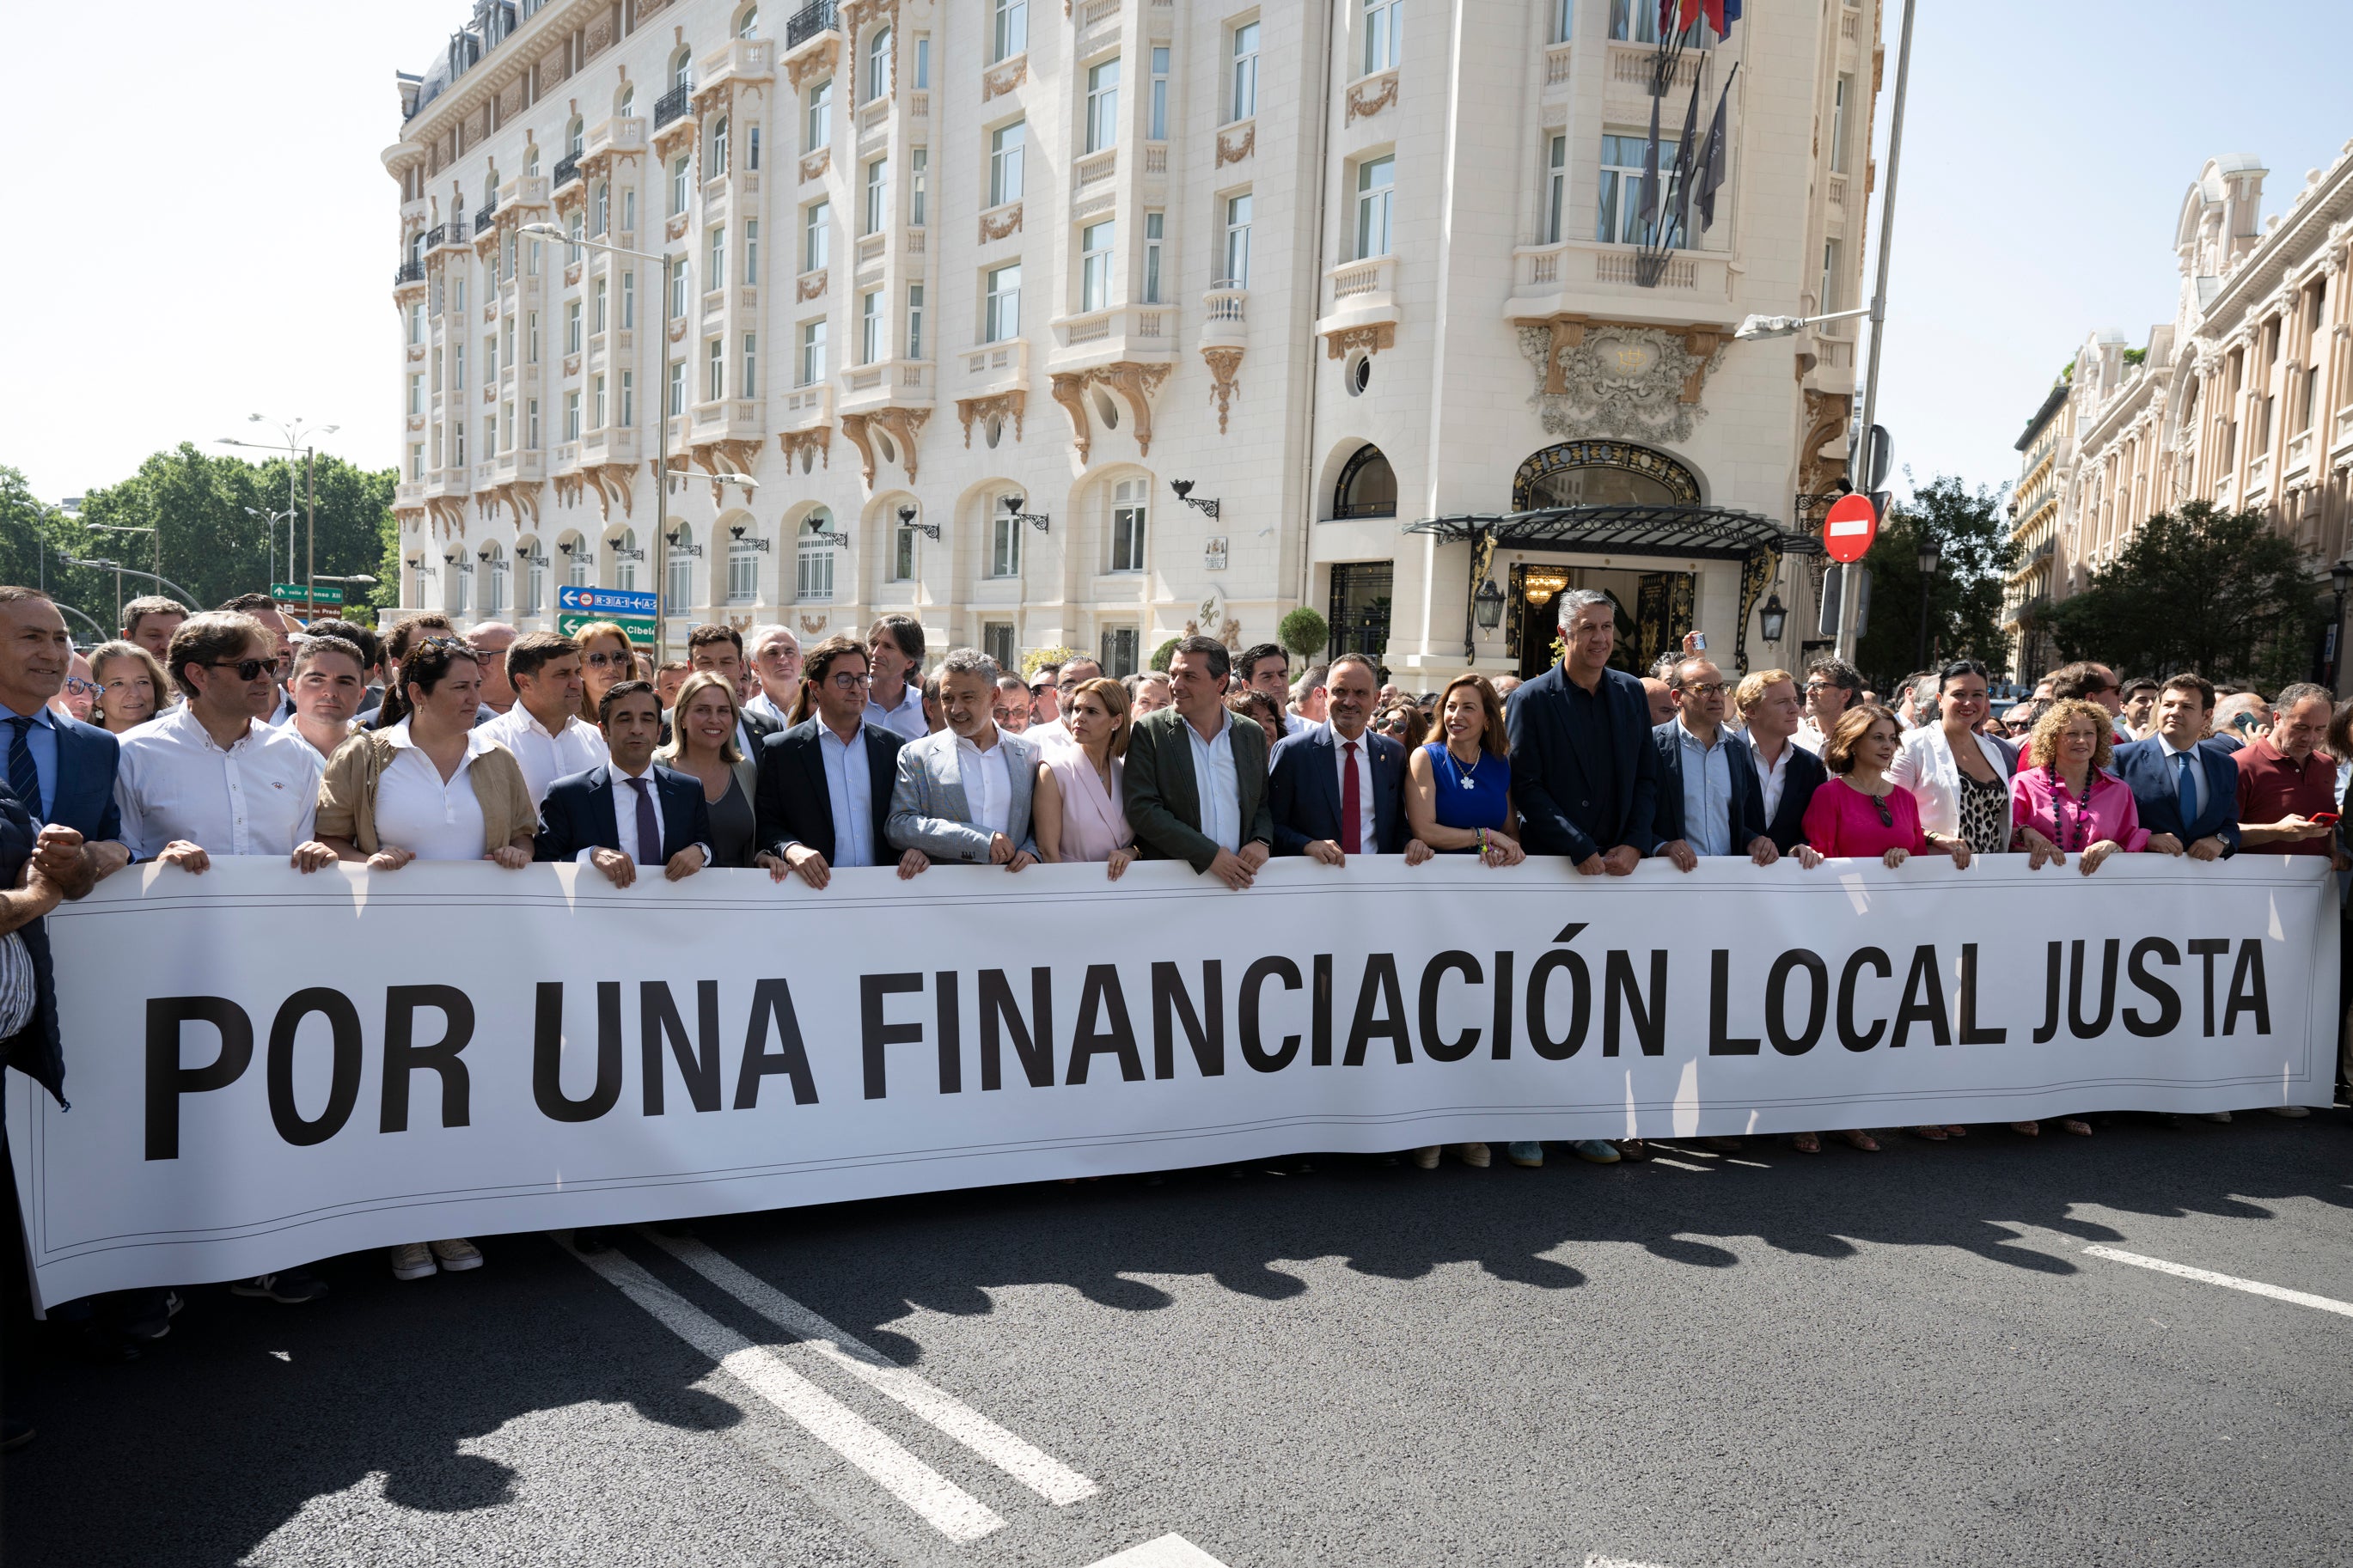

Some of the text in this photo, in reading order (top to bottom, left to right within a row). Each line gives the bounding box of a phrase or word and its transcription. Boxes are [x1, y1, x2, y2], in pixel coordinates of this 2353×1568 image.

[144, 922, 2271, 1162] POR UNA FINANCIACIÓN LOCAL JUSTA
